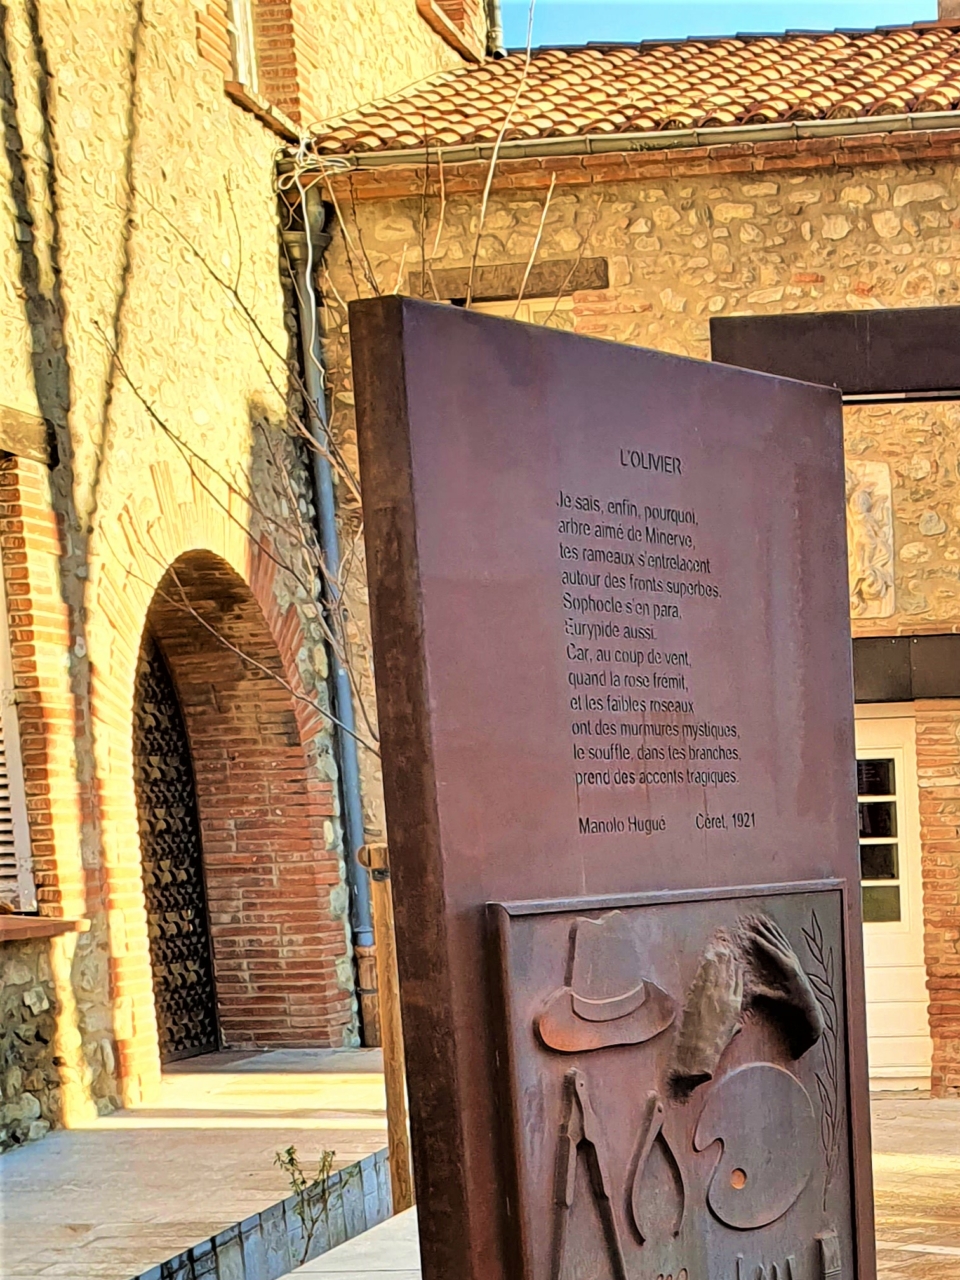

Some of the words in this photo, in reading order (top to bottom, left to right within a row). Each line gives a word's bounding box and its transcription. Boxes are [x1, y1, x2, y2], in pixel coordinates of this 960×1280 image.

[619, 448, 682, 475] L'OLIVIER
[556, 490, 571, 508] Je
[558, 518, 591, 535] arbre
[594, 522, 624, 539] aimé
[627, 524, 642, 542] de
[645, 526, 695, 550] Minerve,
[559, 542, 579, 560] tes
[582, 547, 635, 566] rameaux
[638, 550, 711, 574] s'entrelacent
[562, 570, 600, 588] autour
[604, 572, 626, 589] des
[629, 574, 663, 592] fronts
[563, 591, 622, 614] Sophocle
[625, 598, 650, 615] s'en
[565, 618, 620, 640] Eurypide
[566, 643, 593, 663] Car,
[597, 649, 611, 662] au
[615, 649, 644, 667] coup
[647, 649, 662, 665] de
[664, 651, 692, 667] vent,
[568, 670, 607, 688] quand
[610, 671, 621, 686] la
[624, 674, 650, 688] rose
[653, 672, 689, 693] frémit,
[570, 696, 582, 711] et
[585, 695, 604, 711] les
[607, 695, 647, 712] faibles
[650, 699, 694, 714] roseaux
[571, 720, 591, 735] ont
[595, 719, 617, 736] des
[620, 722, 679, 737] murmures
[573, 744, 585, 760] le
[637, 745, 665, 760] dans
[668, 745, 686, 760] tes
[575, 770, 610, 785] prend
[614, 769, 636, 784] des
[639, 770, 683, 784] accents
[686, 768, 739, 788] tragiques.
[578, 817, 624, 834] Manolo
[628, 815, 666, 836] Hugué
[695, 813, 728, 830] Céret,
[731, 812, 756, 829] 1921
